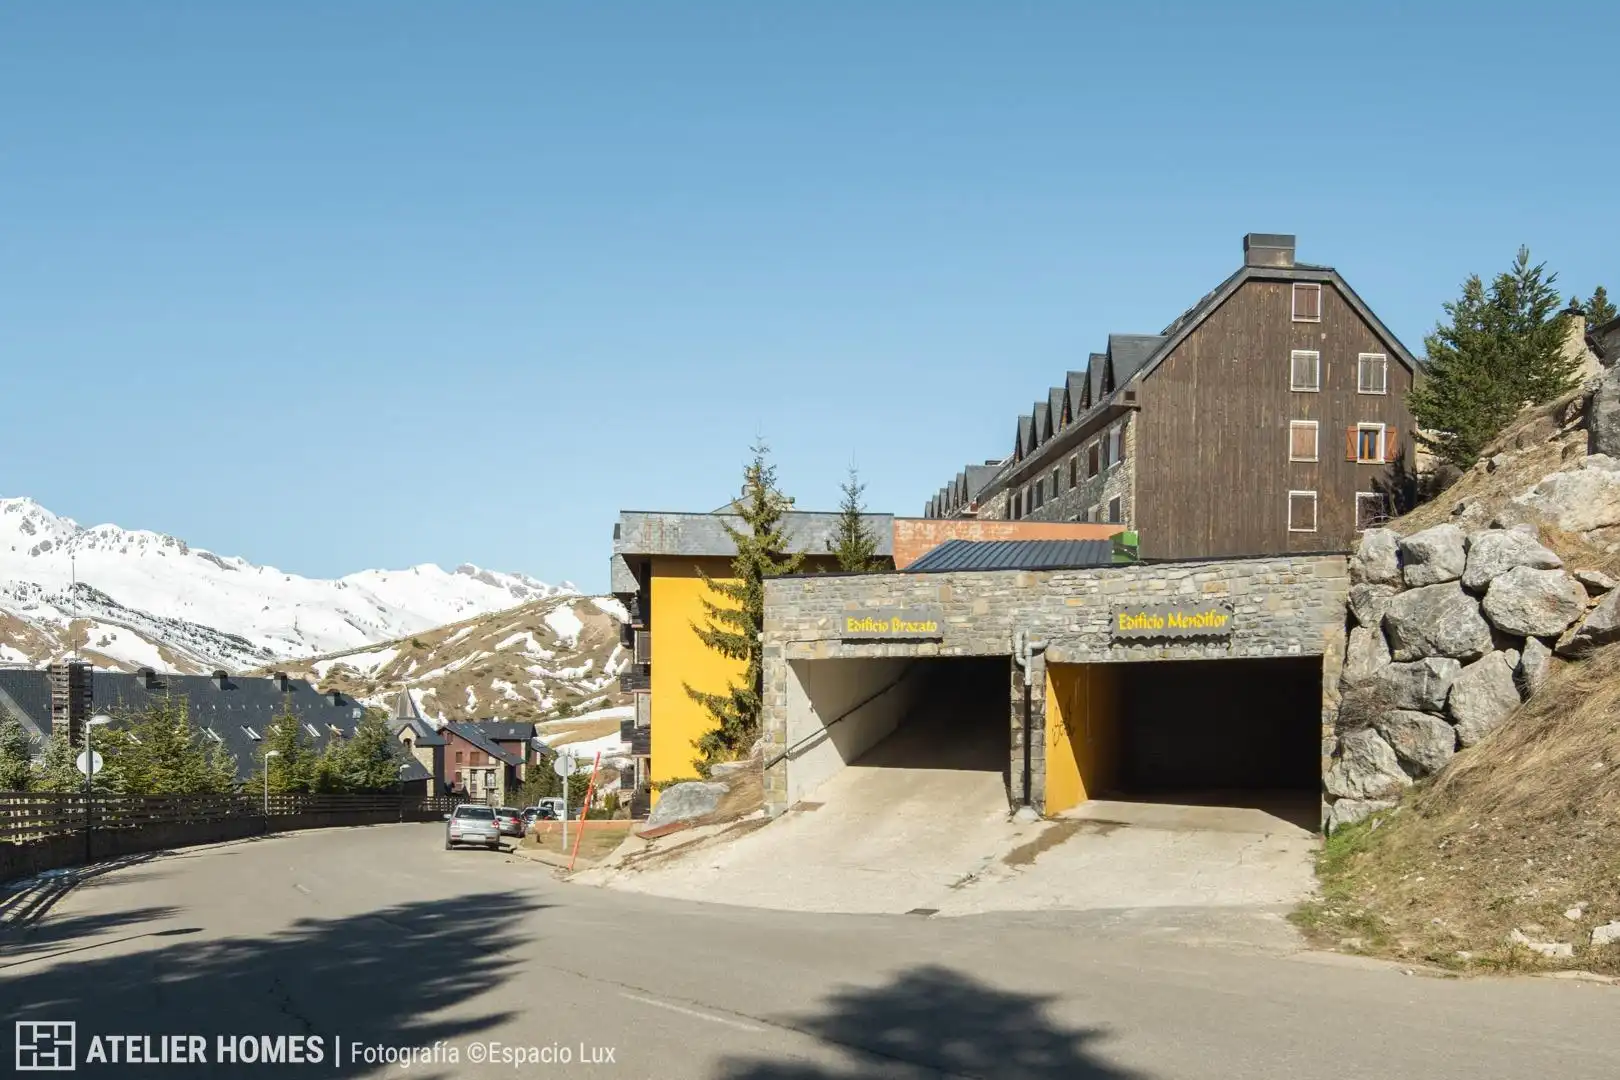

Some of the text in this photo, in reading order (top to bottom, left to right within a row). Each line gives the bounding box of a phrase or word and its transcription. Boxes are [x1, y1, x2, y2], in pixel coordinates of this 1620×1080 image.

[846, 616, 938, 633] Edificio Brazato
[1118, 608, 1229, 631] Edificio Mendifor
